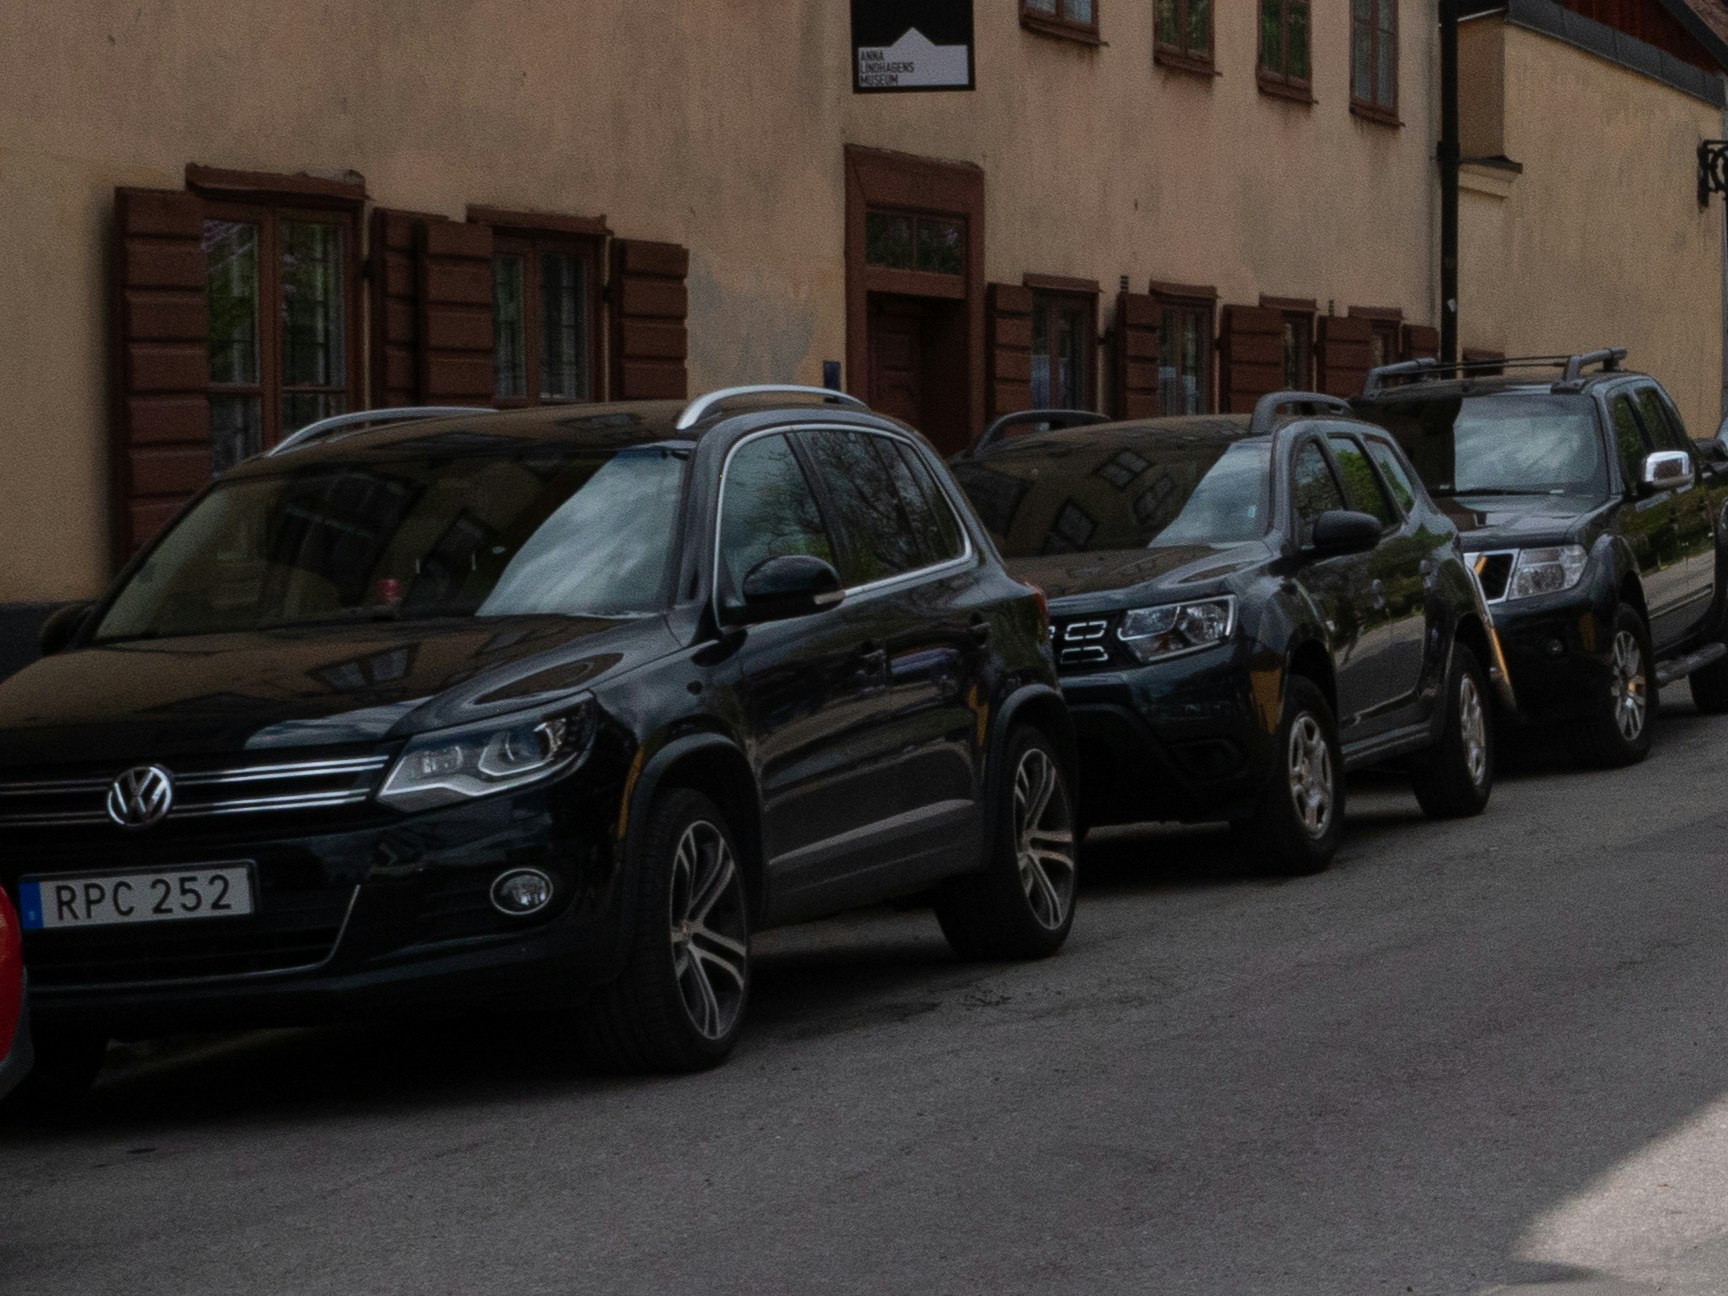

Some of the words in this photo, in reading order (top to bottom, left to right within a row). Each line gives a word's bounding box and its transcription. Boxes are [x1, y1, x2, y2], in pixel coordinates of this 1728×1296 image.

[860, 51, 884, 61] ANNA
[860, 62, 915, 74] LINDHAGENS
[861, 74, 899, 85] MUSEUM
[55, 881, 135, 920] RPC
[150, 874, 232, 914] 252
